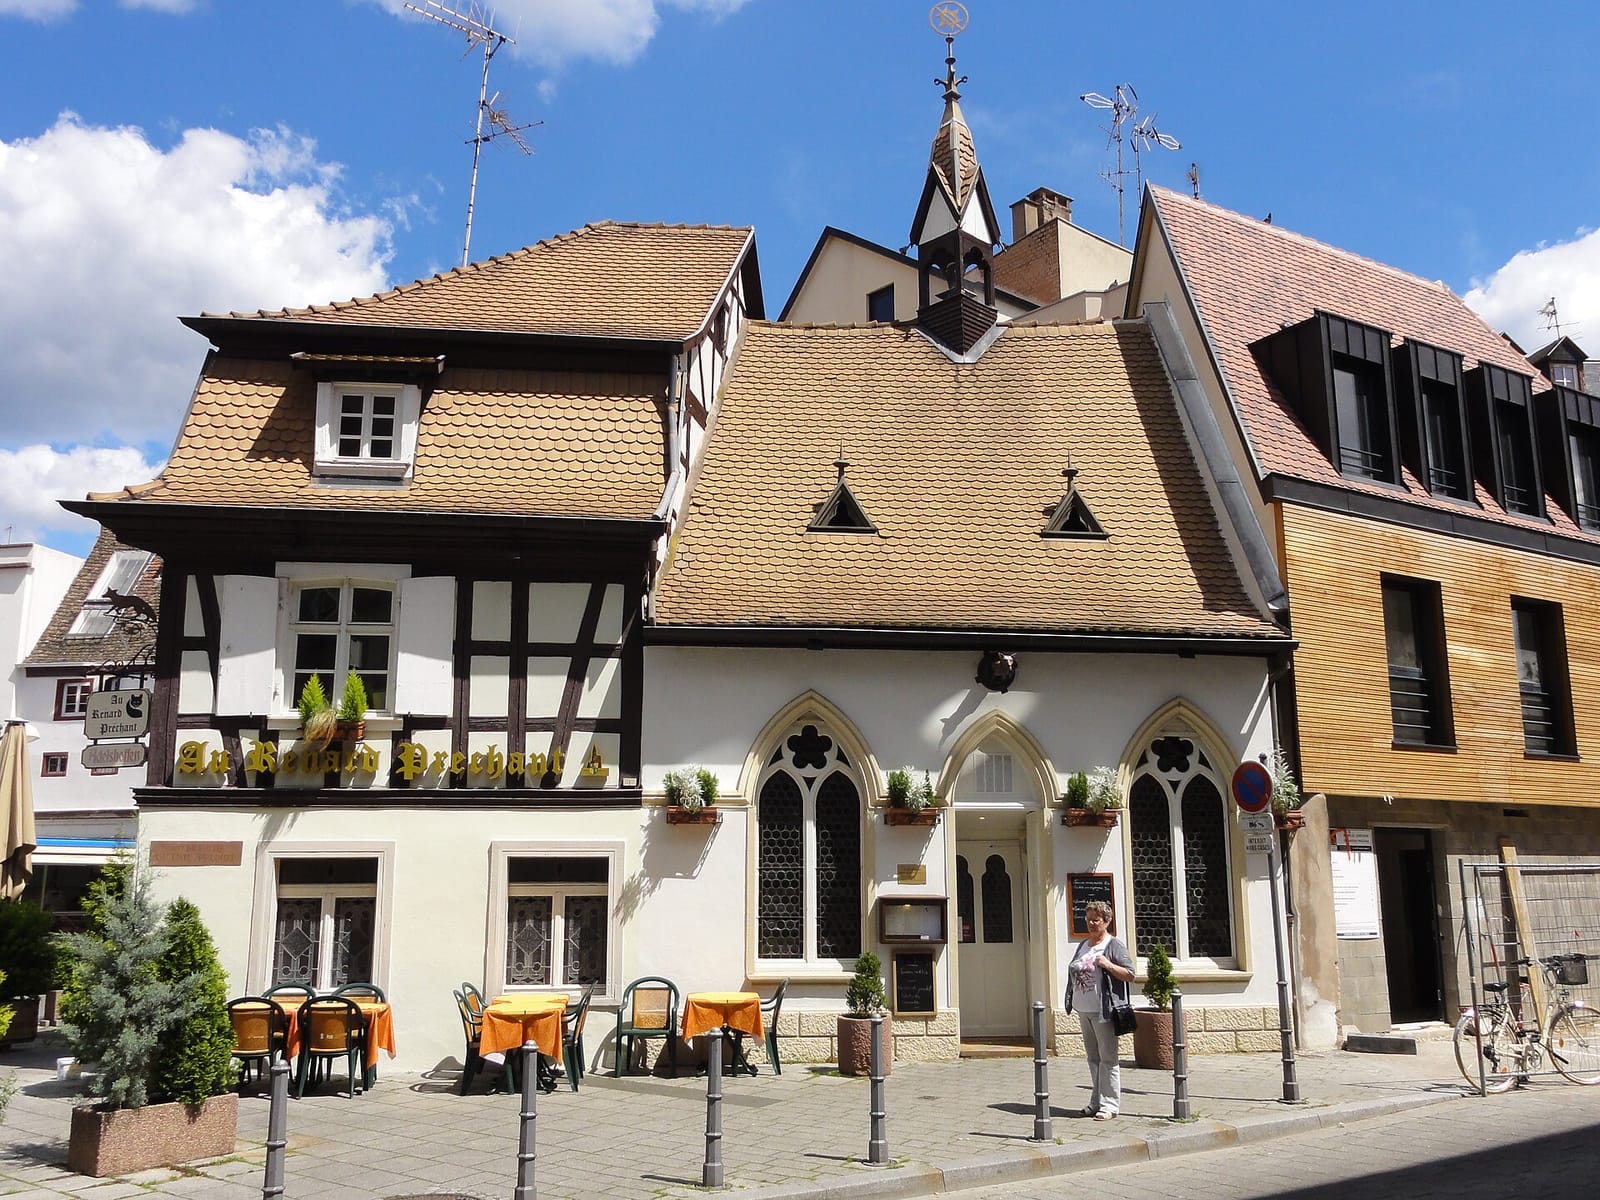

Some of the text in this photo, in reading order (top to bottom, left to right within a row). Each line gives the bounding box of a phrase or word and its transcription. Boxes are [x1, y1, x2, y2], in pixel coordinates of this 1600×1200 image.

[111, 694, 123, 705] Au
[92, 709, 122, 719] Renard
[179, 740, 566, 780] Au Renard Prechant
